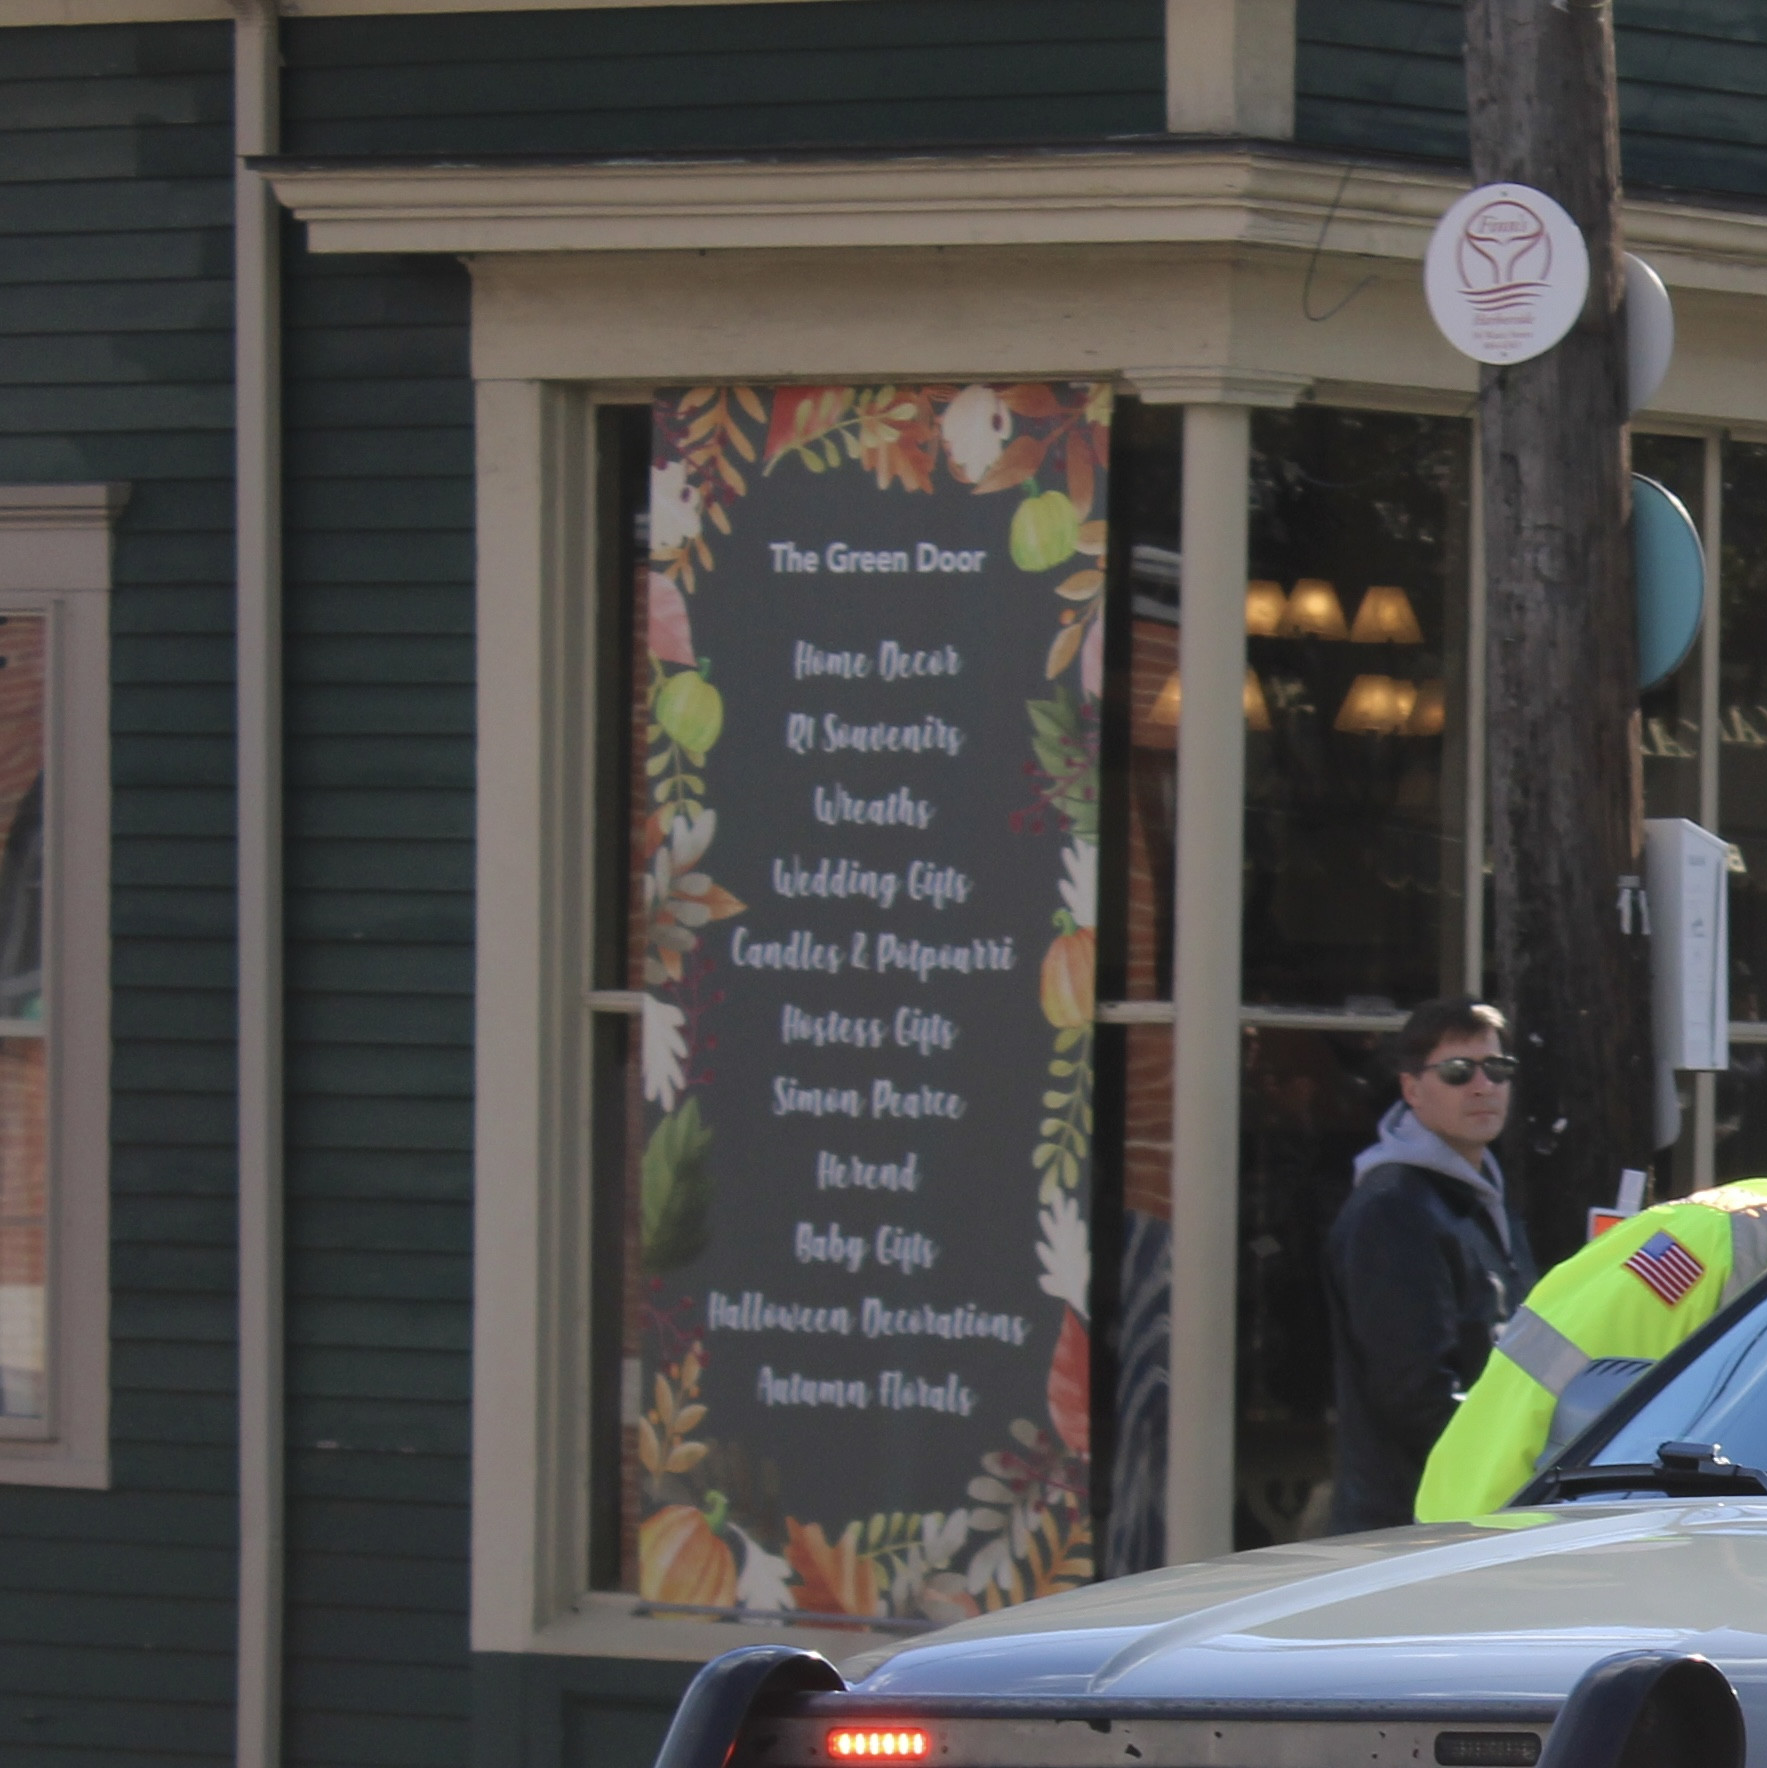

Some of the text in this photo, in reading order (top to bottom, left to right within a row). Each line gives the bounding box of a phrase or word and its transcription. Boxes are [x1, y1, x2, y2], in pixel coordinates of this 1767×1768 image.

[769, 541, 986, 573] The Green Door
[794, 639, 962, 681] Home Decor
[823, 713, 965, 757] Souvenirs
[813, 784, 936, 830] Wreaths
[772, 855, 973, 910] Wedding Gifts
[731, 926, 842, 974] Candles
[876, 934, 1017, 982] Potpourri
[781, 1003, 960, 1056] Hostess Gifts
[773, 1076, 967, 1120] Simon Pearce
[816, 1150, 924, 1193] Herend
[795, 1221, 940, 1275] Baby Gifts
[708, 1290, 1033, 1347] Halloween Decorations
[757, 1364, 979, 1417] Autumn Florals
